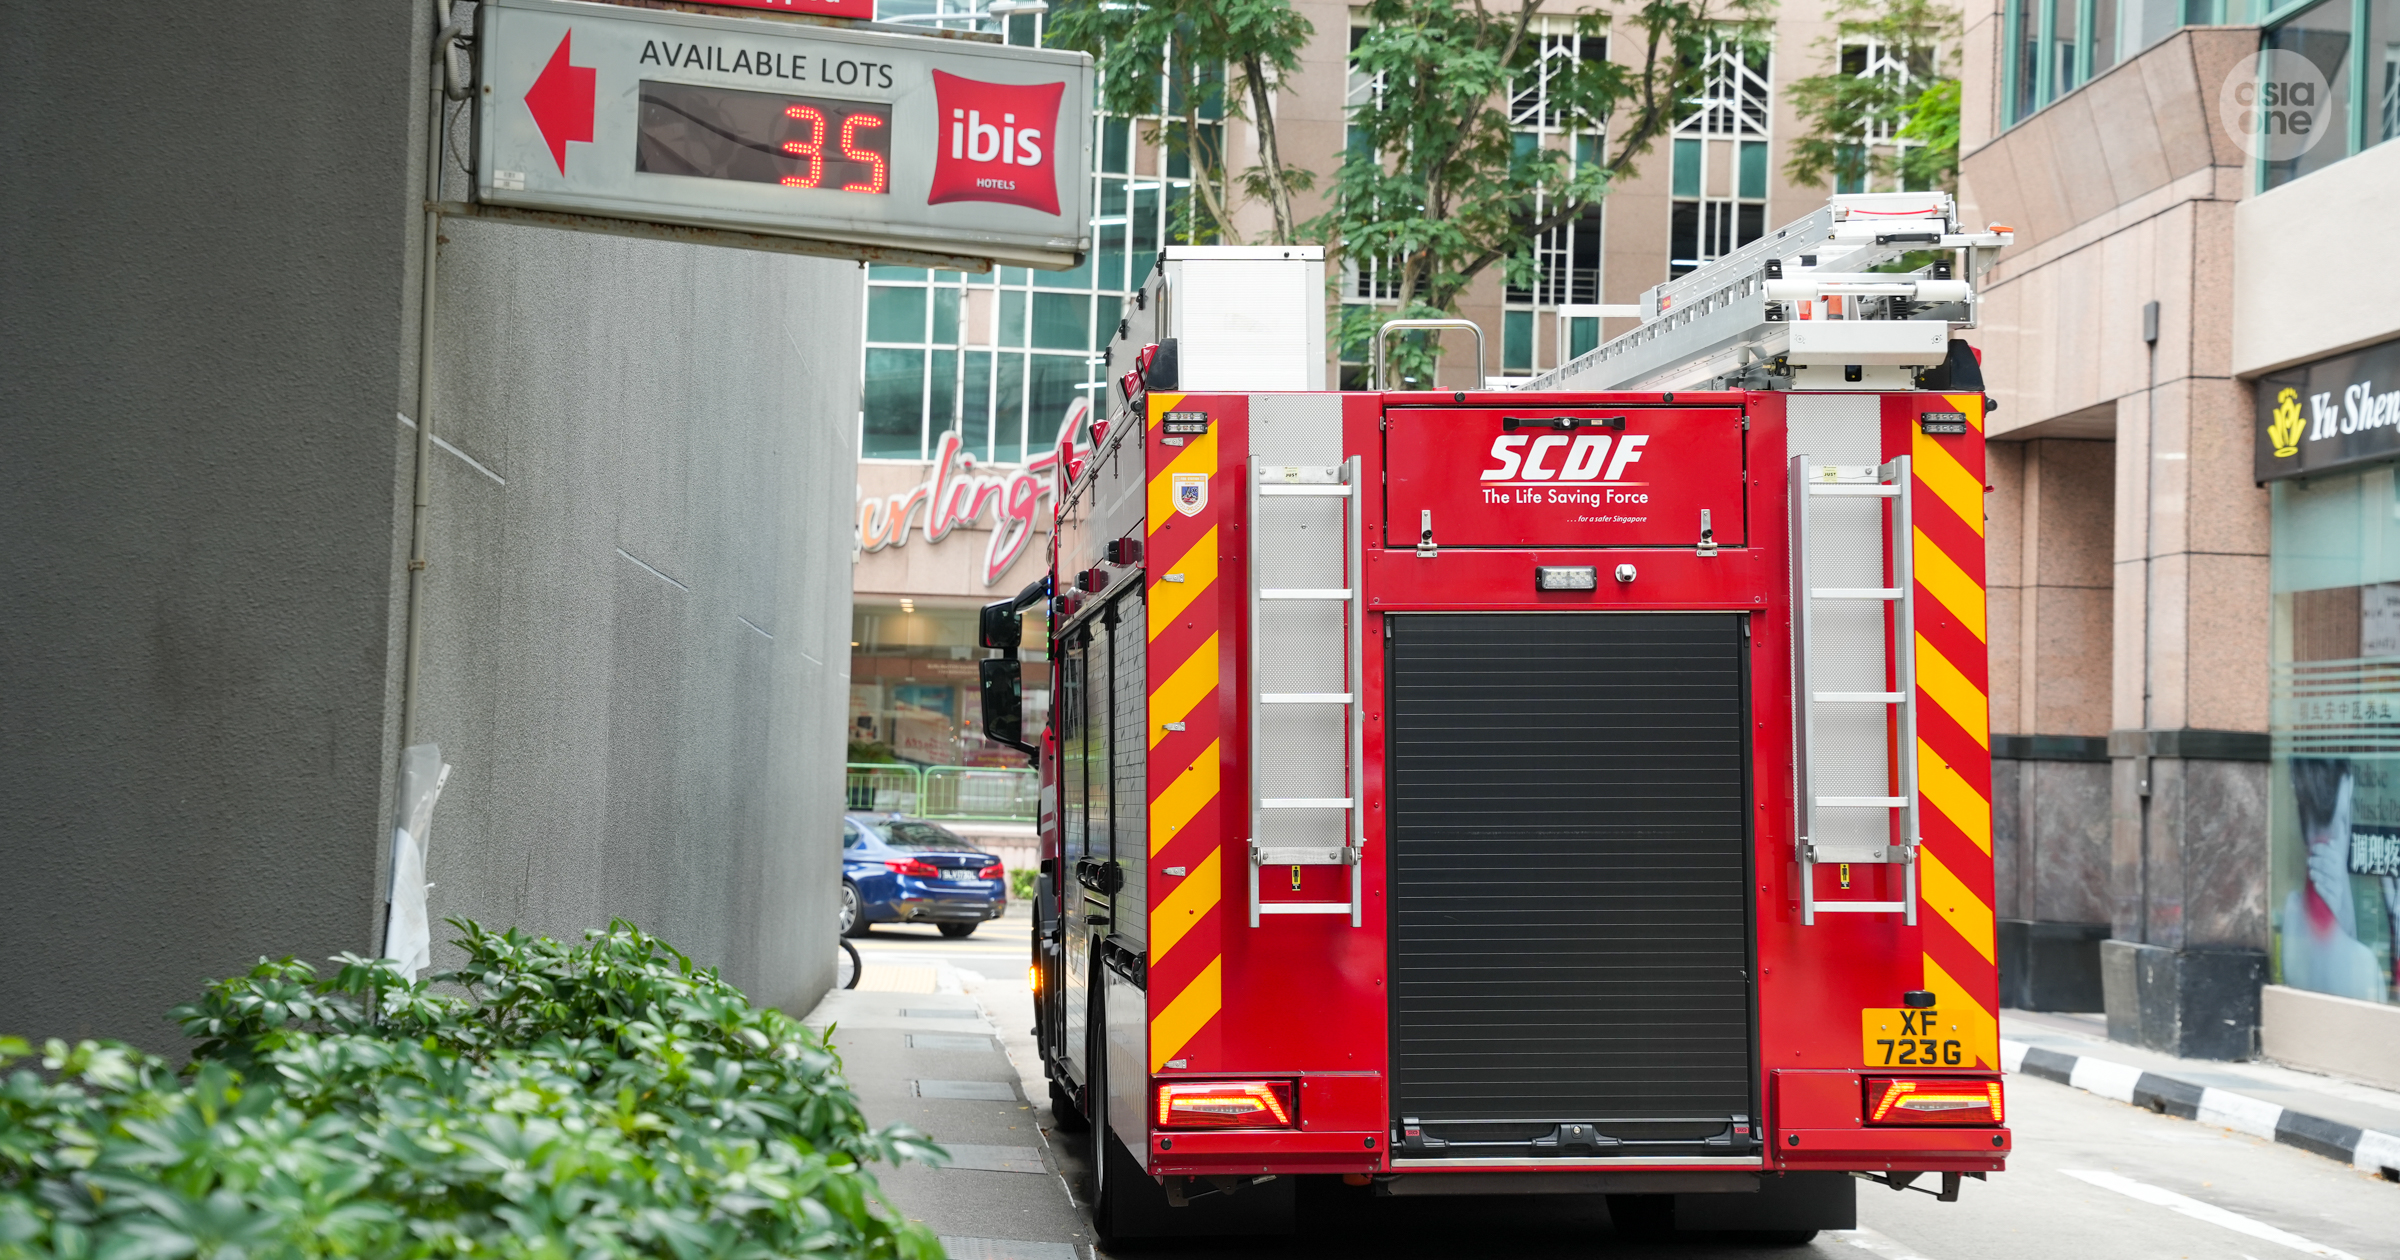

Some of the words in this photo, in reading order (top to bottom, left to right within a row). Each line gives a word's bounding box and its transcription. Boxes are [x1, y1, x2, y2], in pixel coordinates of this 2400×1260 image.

[640, 39, 806, 80] AVAILABLE
[821, 57, 894, 89] LOTS
[780, 104, 884, 194] 35
[951, 107, 1042, 167] ibis
[975, 176, 1016, 191] HOTELS
[2308, 391, 2339, 442] Yu
[2339, 380, 2400, 435] Shen
[1479, 434, 1649, 481] SCDF
[1482, 488, 1510, 504] The
[1515, 488, 1542, 504] Life
[1547, 488, 1601, 508] Saving
[1605, 488, 1649, 504] Force
[1595, 514, 1612, 523] safer
[1612, 515, 1648, 524] Singapore
[1900, 1010, 1938, 1036] XF
[1877, 1039, 1961, 1065] 723G
